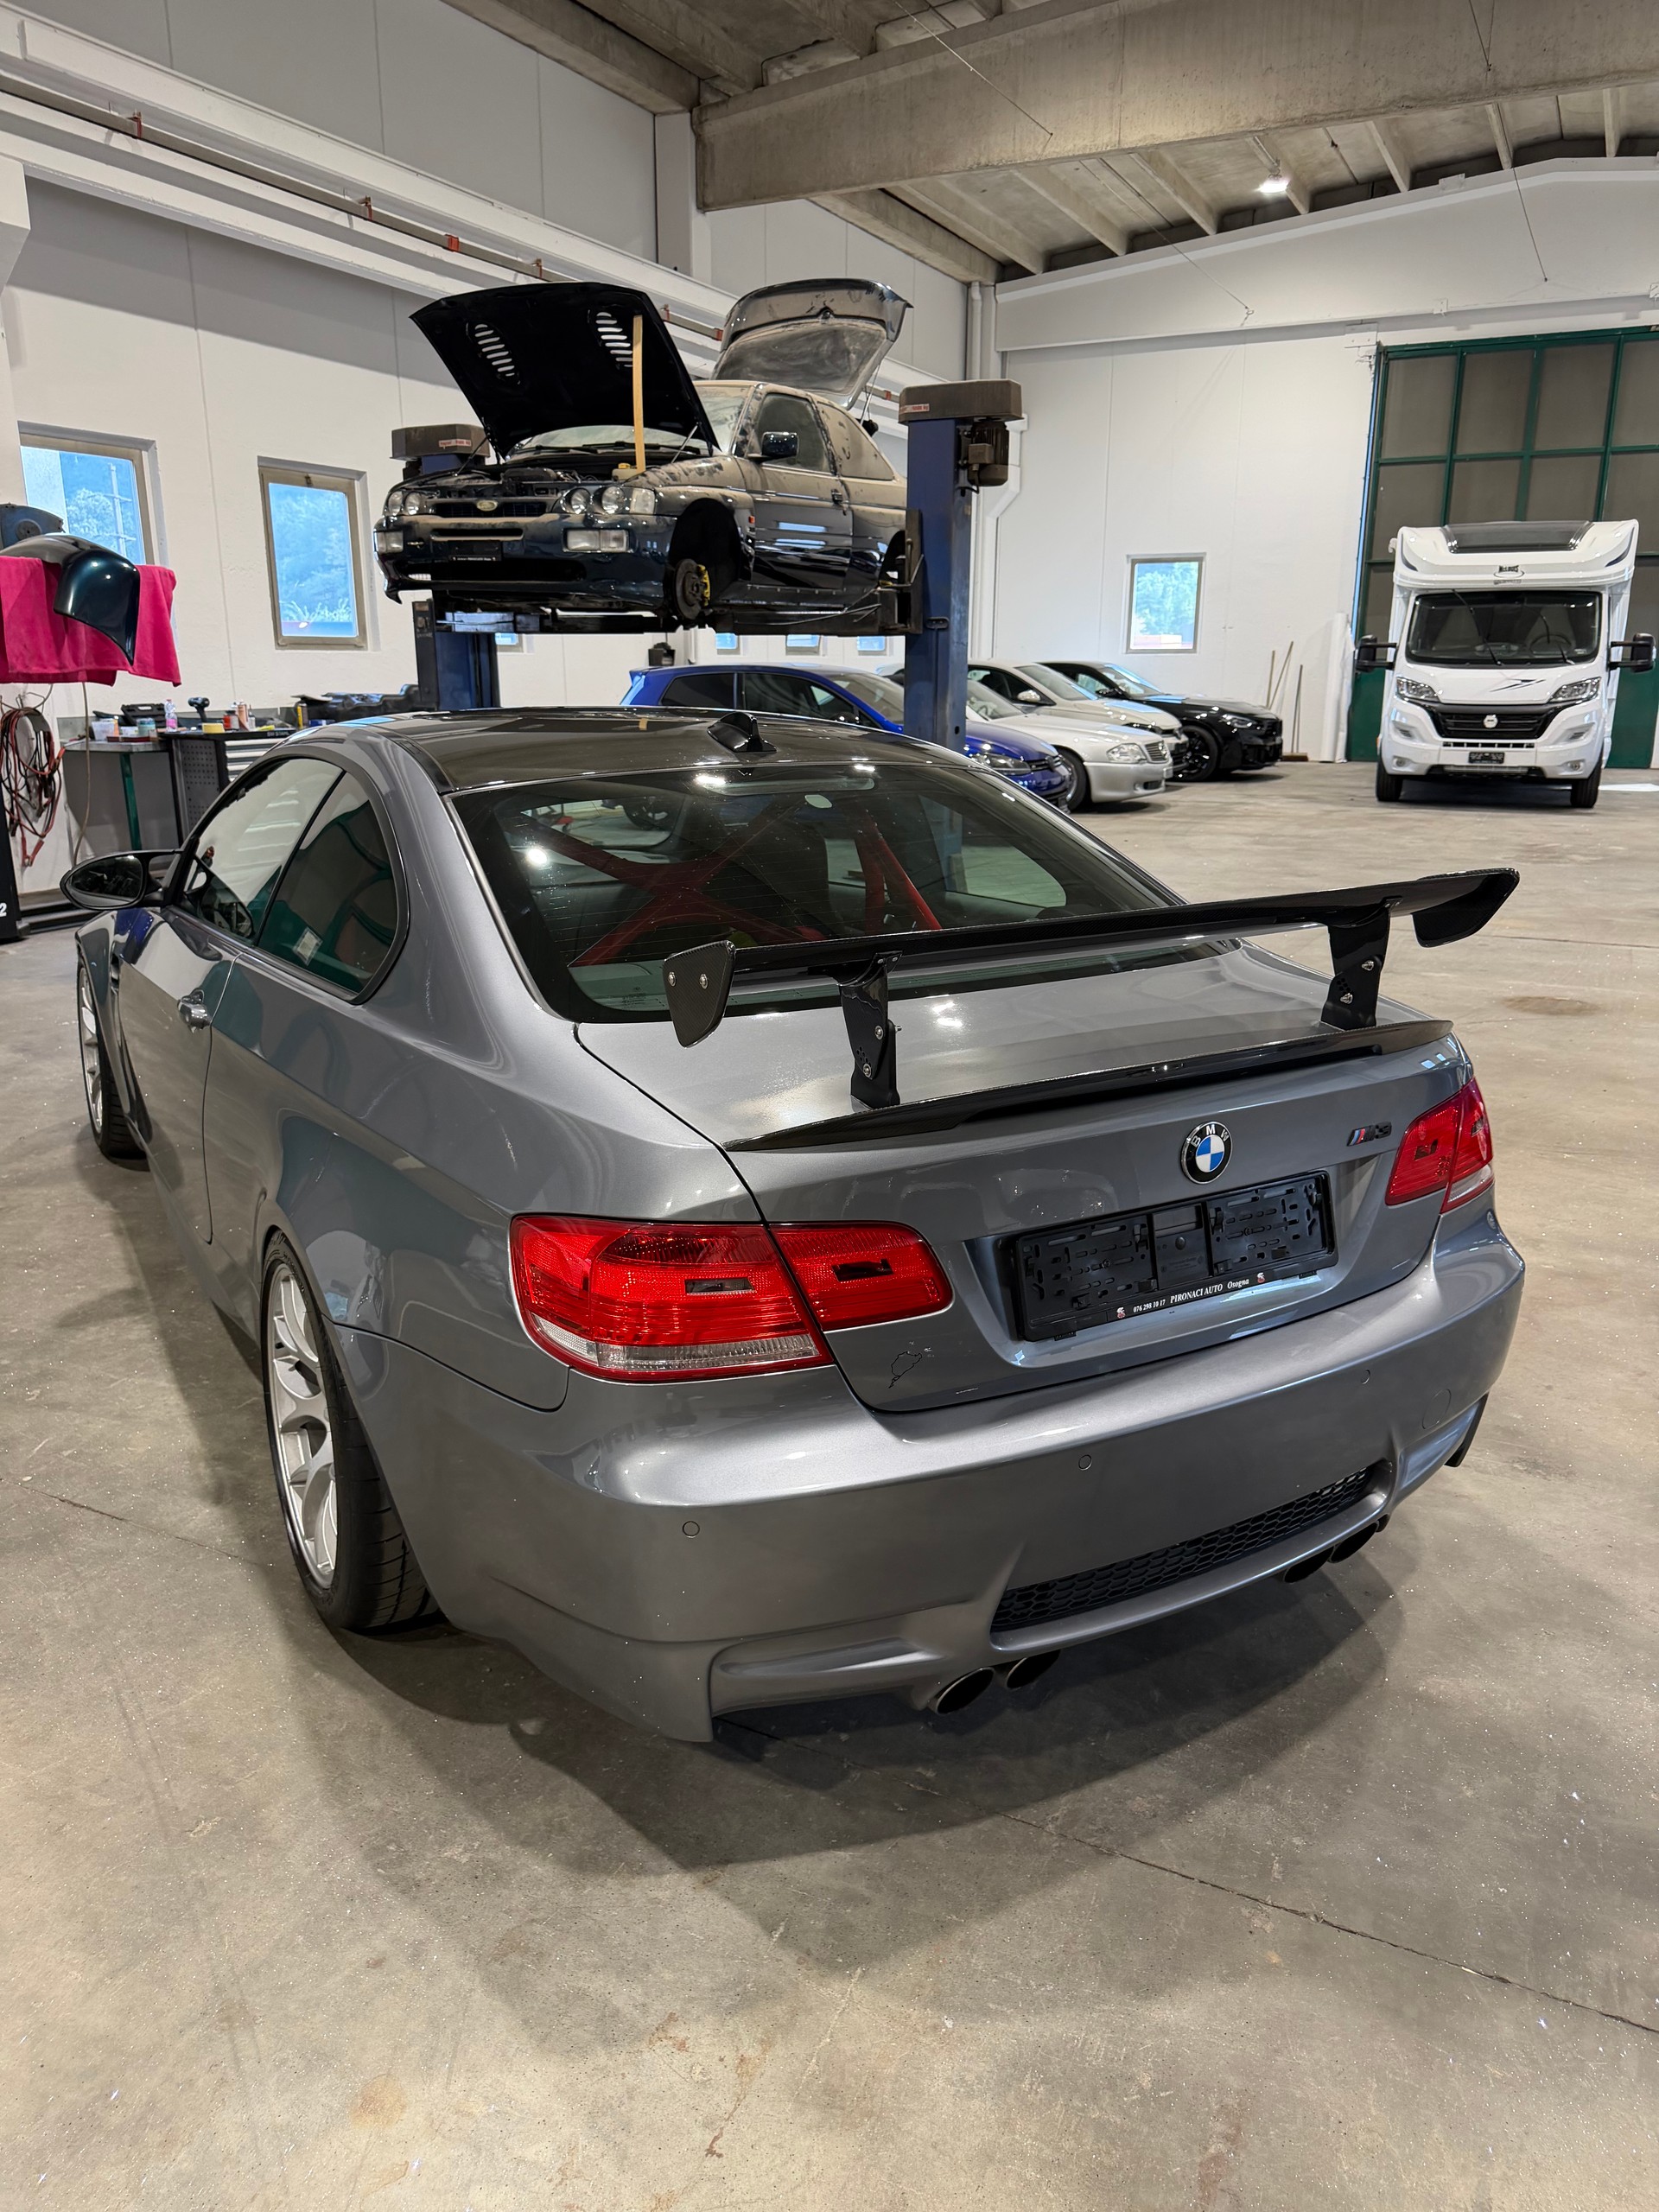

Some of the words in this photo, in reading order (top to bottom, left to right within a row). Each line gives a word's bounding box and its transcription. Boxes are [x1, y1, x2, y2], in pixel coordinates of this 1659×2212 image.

[1191, 1123, 1230, 1147] BMW
[1170, 1287, 1204, 1304] PIRONACI
[1204, 1283, 1224, 1296] AUTO
[1227, 1278, 1249, 1290] Osogna
